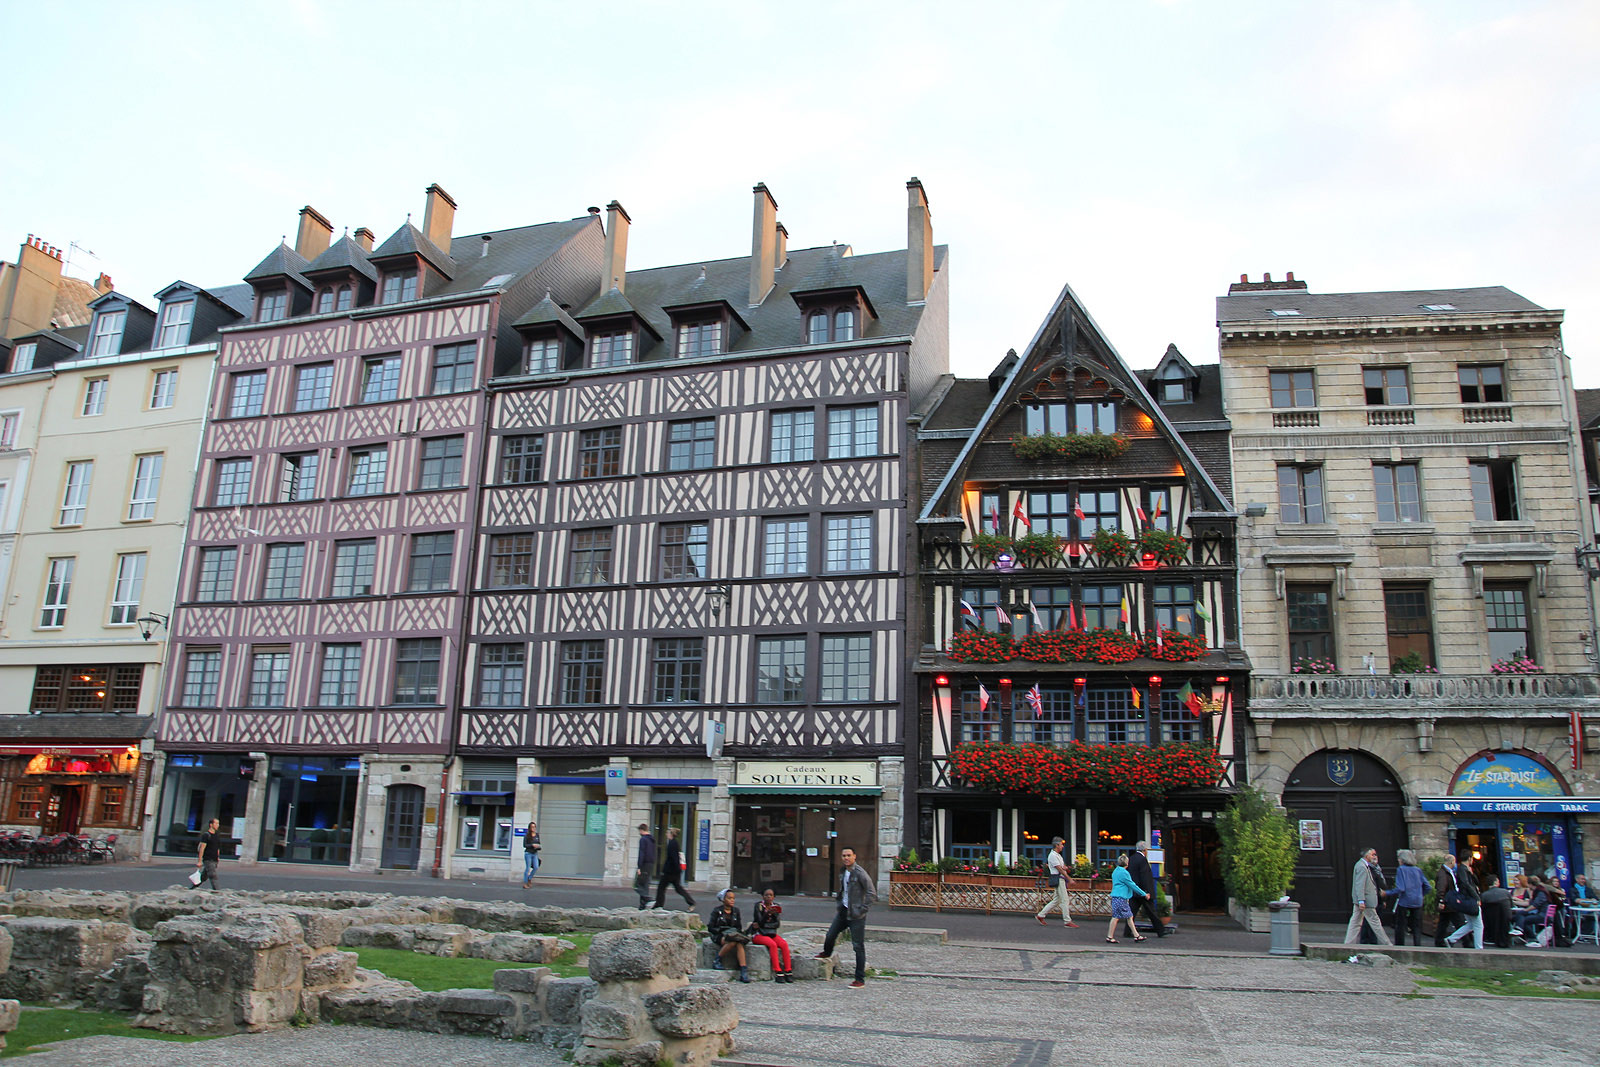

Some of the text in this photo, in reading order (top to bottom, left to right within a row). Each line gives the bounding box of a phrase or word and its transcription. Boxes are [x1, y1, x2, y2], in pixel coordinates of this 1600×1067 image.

[785, 765, 827, 773] Cadeaux
[1332, 759, 1349, 772] 33
[751, 775, 862, 785] SOUVENIRS
[1467, 769, 1536, 784] LE STARDUST
[1444, 803, 1461, 811] BAR
[1482, 803, 1539, 811] LE STARDUST
[1560, 804, 1589, 812] TABAC
